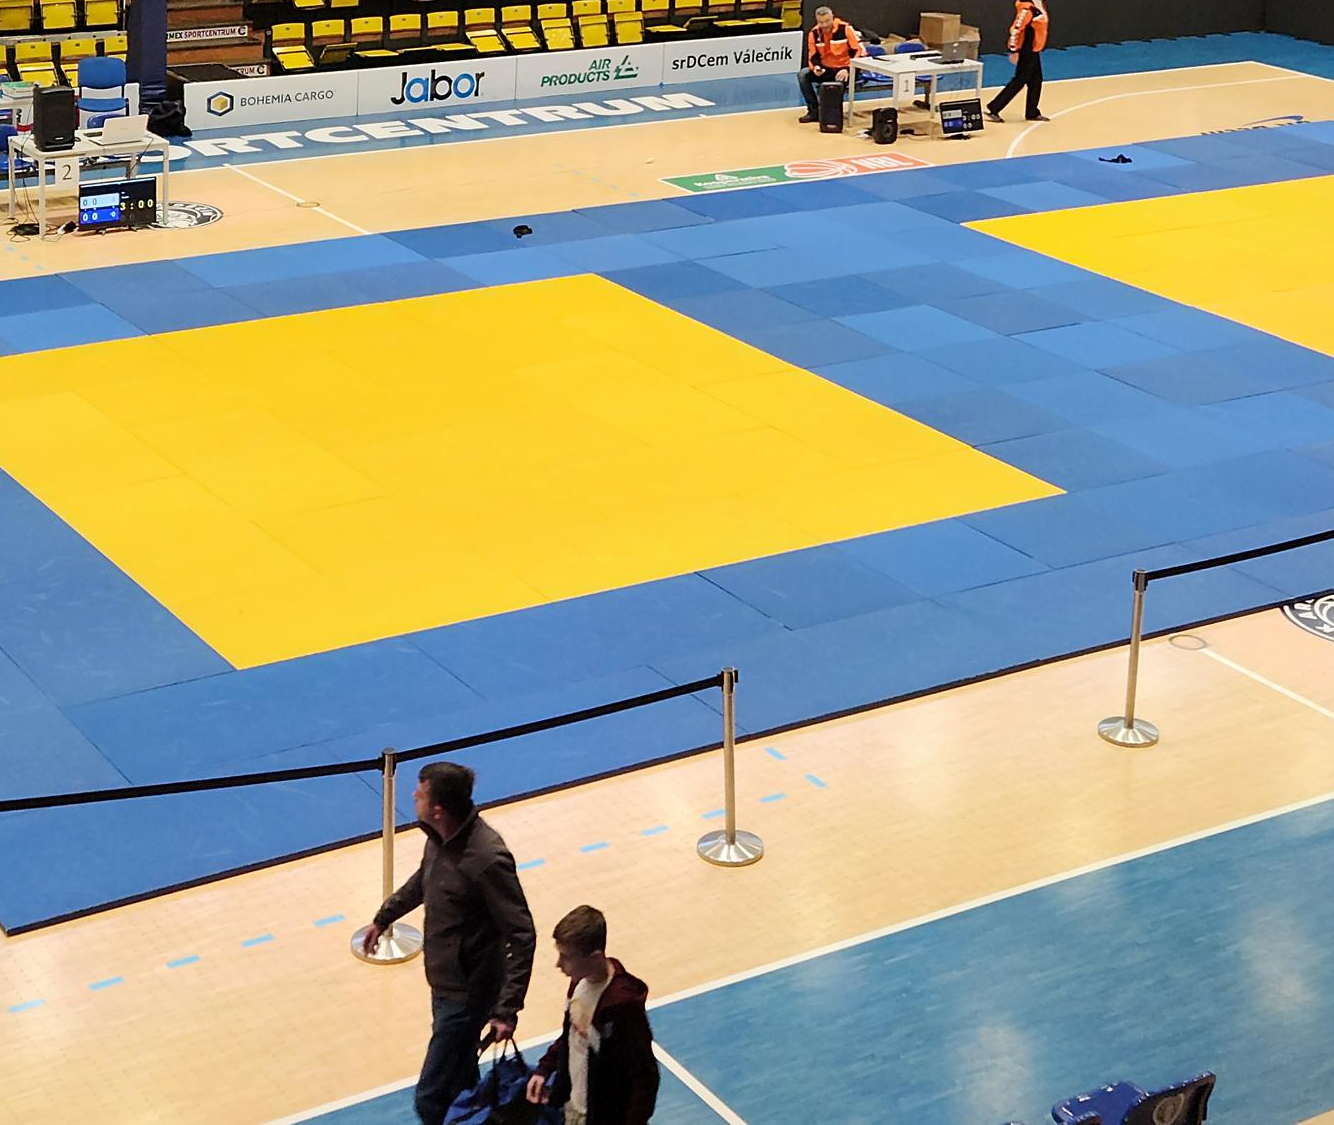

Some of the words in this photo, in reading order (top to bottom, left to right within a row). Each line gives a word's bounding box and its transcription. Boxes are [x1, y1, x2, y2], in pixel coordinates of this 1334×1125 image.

[184, 28, 236, 39] SPORTCENTRUM
[589, 58, 612, 71] AIR
[672, 53, 728, 70] srDCem
[733, 46, 793, 65] Válečník
[390, 68, 485, 106] Jabor
[540, 70, 610, 88] PRODUCTS
[903, 79, 910, 93] 1
[240, 93, 292, 106] BOHEMIA
[294, 90, 335, 102] CARGO
[135, 92, 716, 163] ORTCENTRUM
[62, 164, 72, 180] 2
